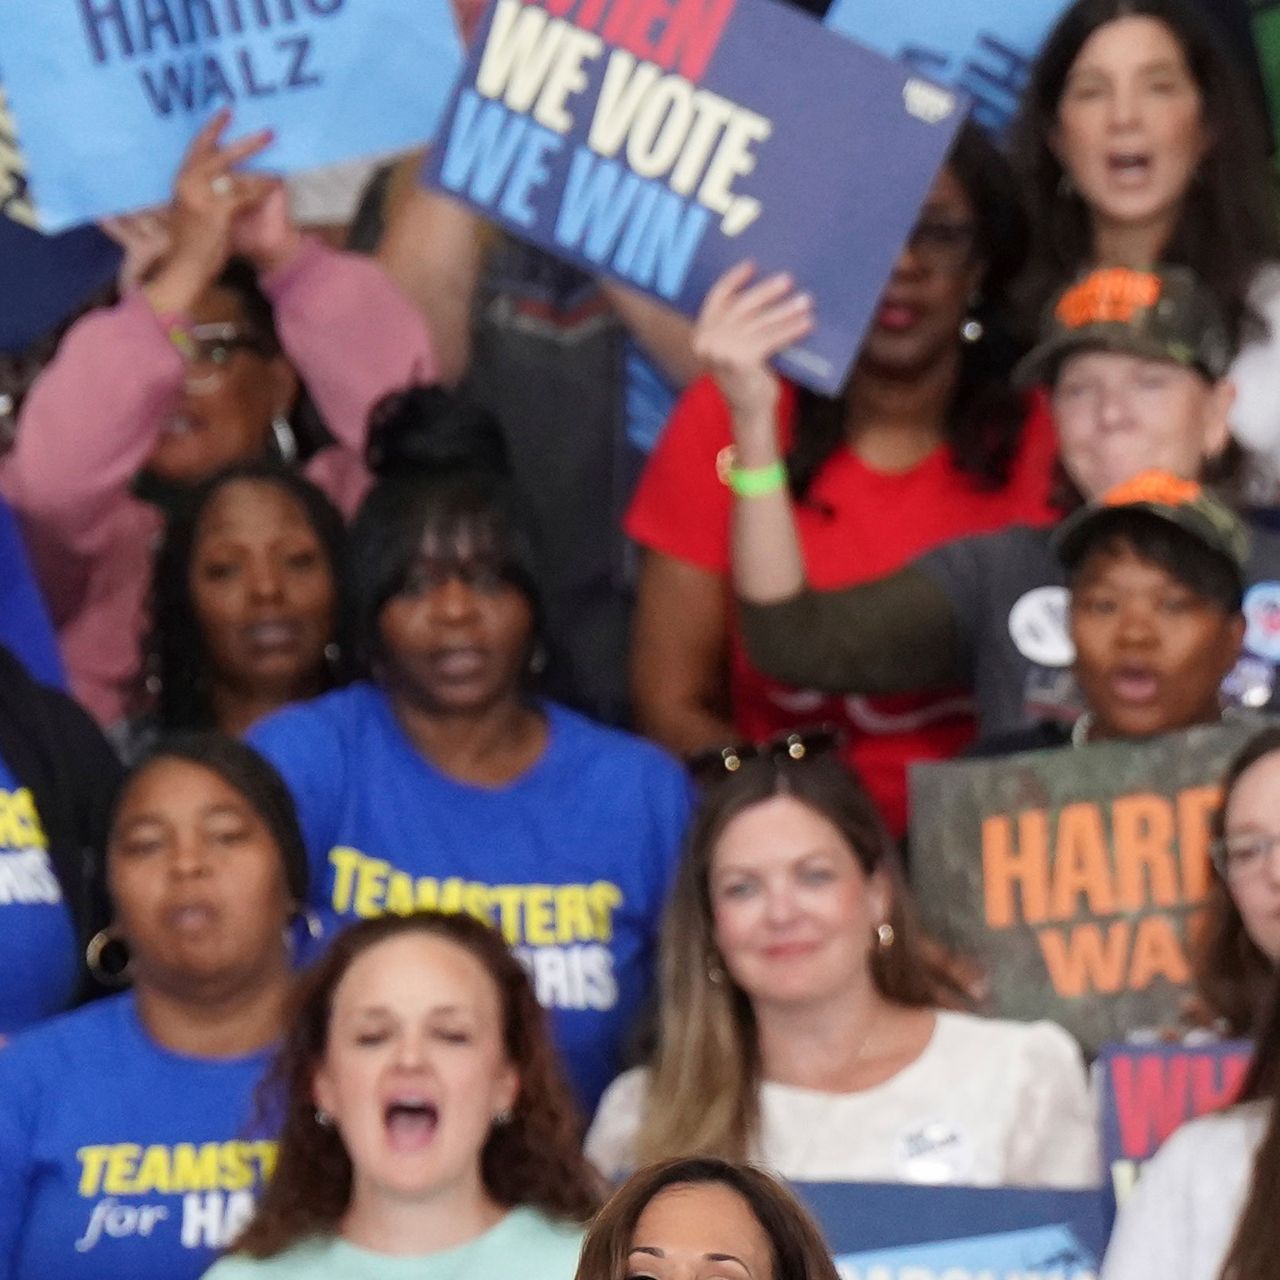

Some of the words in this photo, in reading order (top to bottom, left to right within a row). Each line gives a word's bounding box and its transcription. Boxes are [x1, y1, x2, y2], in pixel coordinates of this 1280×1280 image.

[139, 34, 323, 116] WALZ
[476, 0, 603, 132] WE
[586, 47, 772, 238] VOTE,
[439, 88, 563, 228] WE
[555, 146, 710, 299] WIN
[1038, 911, 1210, 997] WA
[74, 1198, 168, 1253] for
